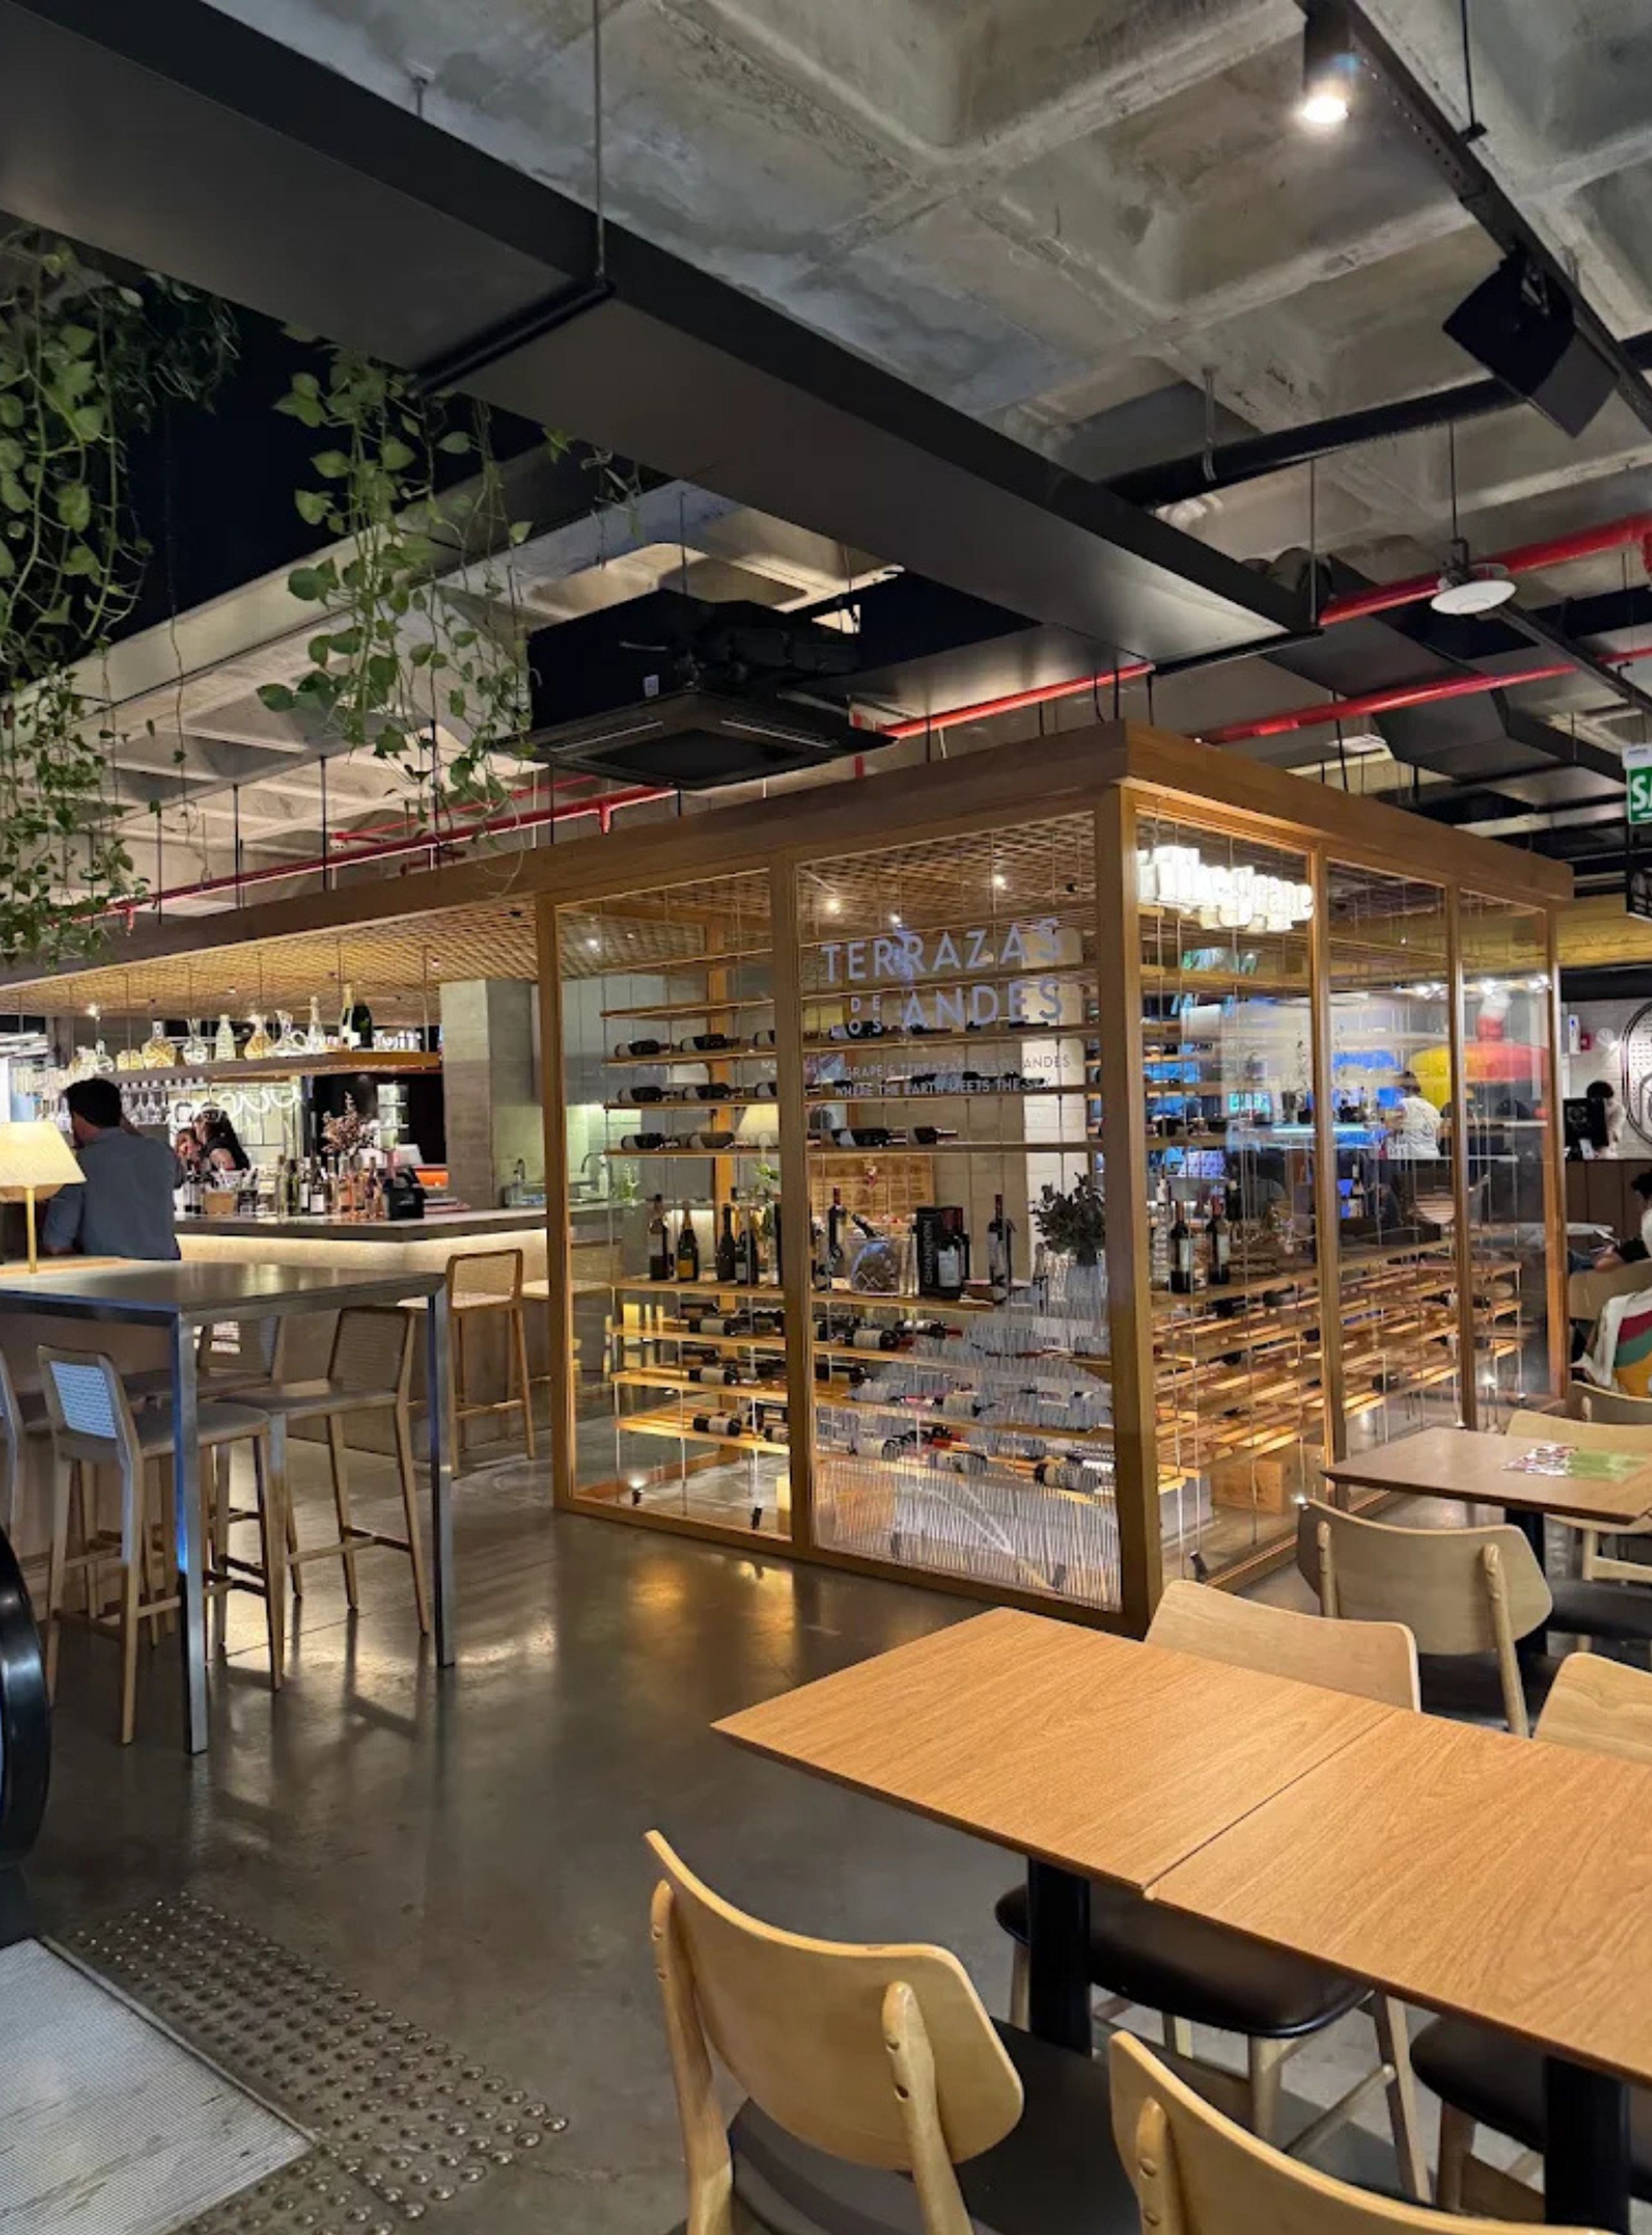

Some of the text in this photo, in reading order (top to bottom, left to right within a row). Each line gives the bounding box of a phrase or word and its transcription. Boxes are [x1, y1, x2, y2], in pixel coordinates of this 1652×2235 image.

[1632, 774, 1652, 811] S
[820, 917, 1062, 984] TERRAZAS
[850, 995, 881, 1013] DE
[903, 976, 1063, 1033] ANDES
[1023, 1054, 1071, 1069] ANDES
[904, 1080, 944, 1096] EARTH
[997, 1077, 1020, 1092] THE
[923, 1220, 933, 1285] CHANDON
